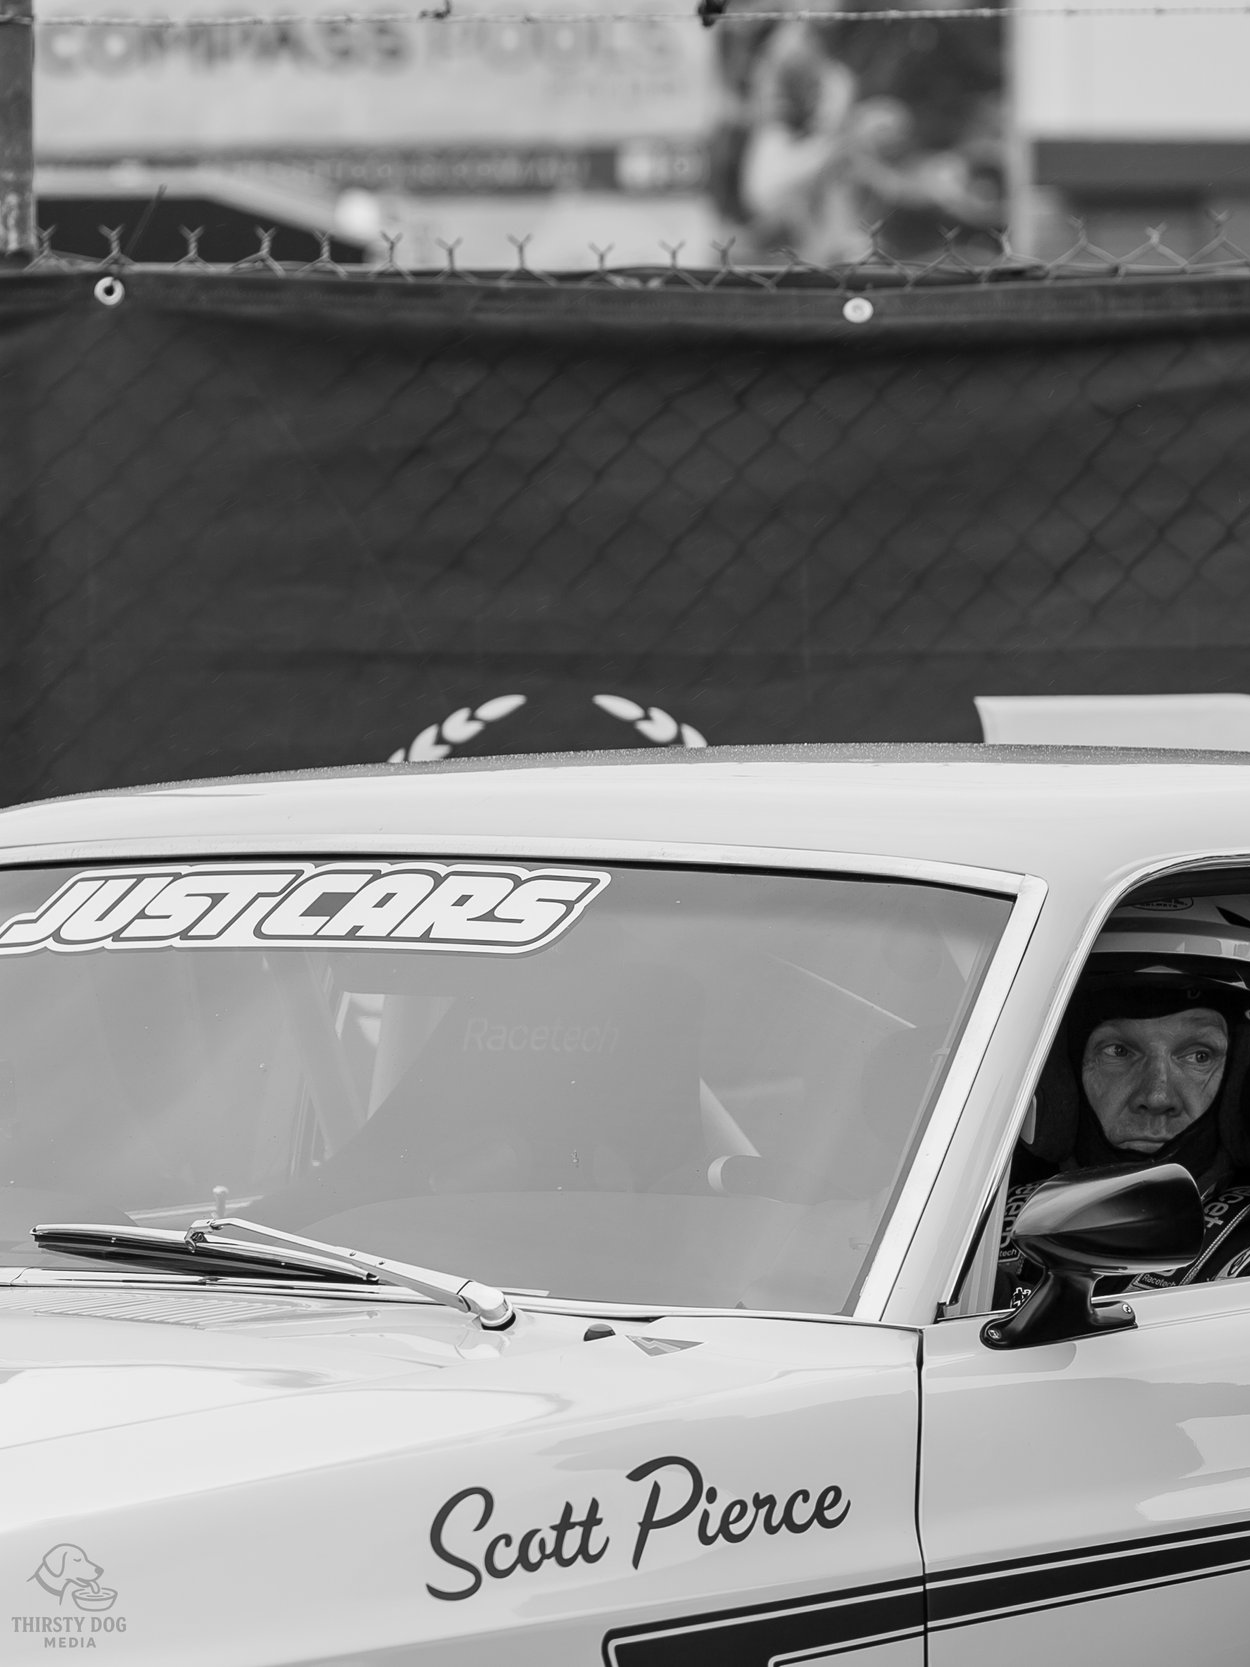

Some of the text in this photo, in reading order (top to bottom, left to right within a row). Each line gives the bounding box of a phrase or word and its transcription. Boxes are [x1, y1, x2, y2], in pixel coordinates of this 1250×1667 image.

[2, 870, 598, 944] JUST CARS
[426, 1456, 851, 1601] Scott Pierce
